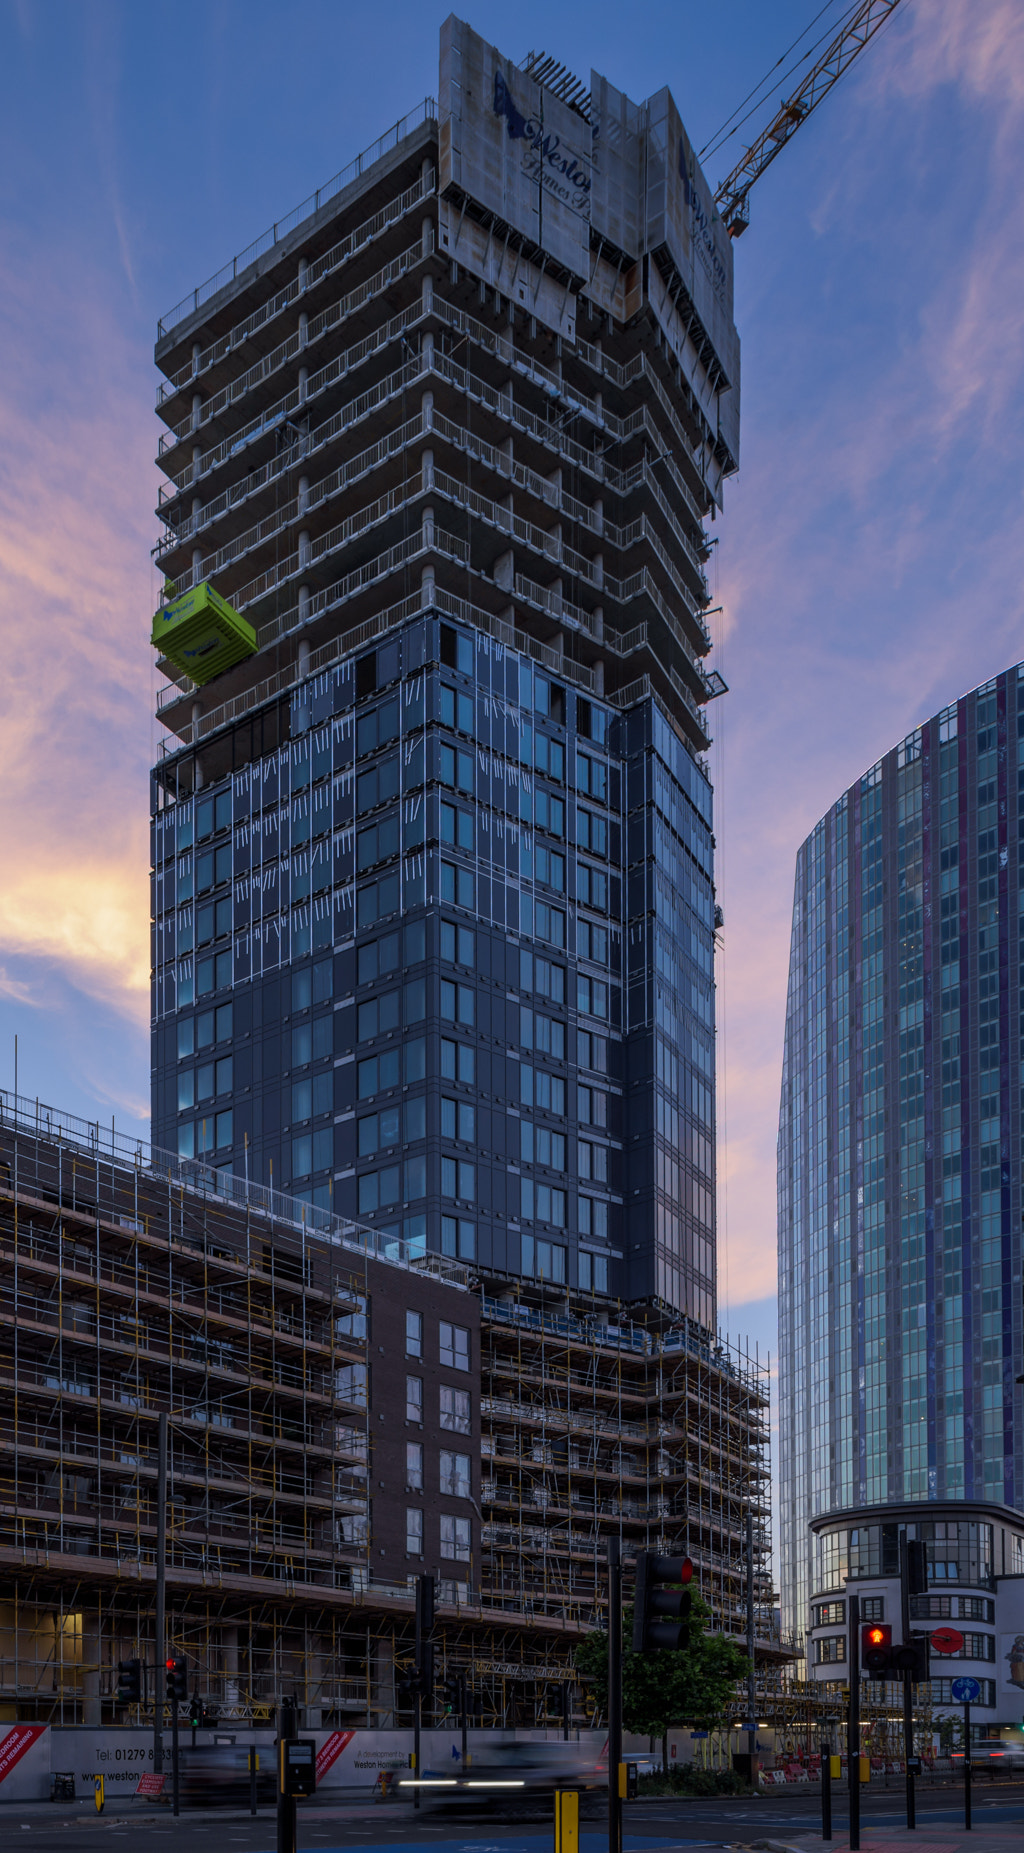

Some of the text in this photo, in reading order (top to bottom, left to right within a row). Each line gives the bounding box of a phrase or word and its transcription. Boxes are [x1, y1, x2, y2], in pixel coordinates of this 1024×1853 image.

[6, 1729, 34, 1762] REMAINING
[96, 1749, 112, 1761] Tel:
[115, 1749, 146, 1761] 01279
[354, 1760, 376, 1769] Weston
